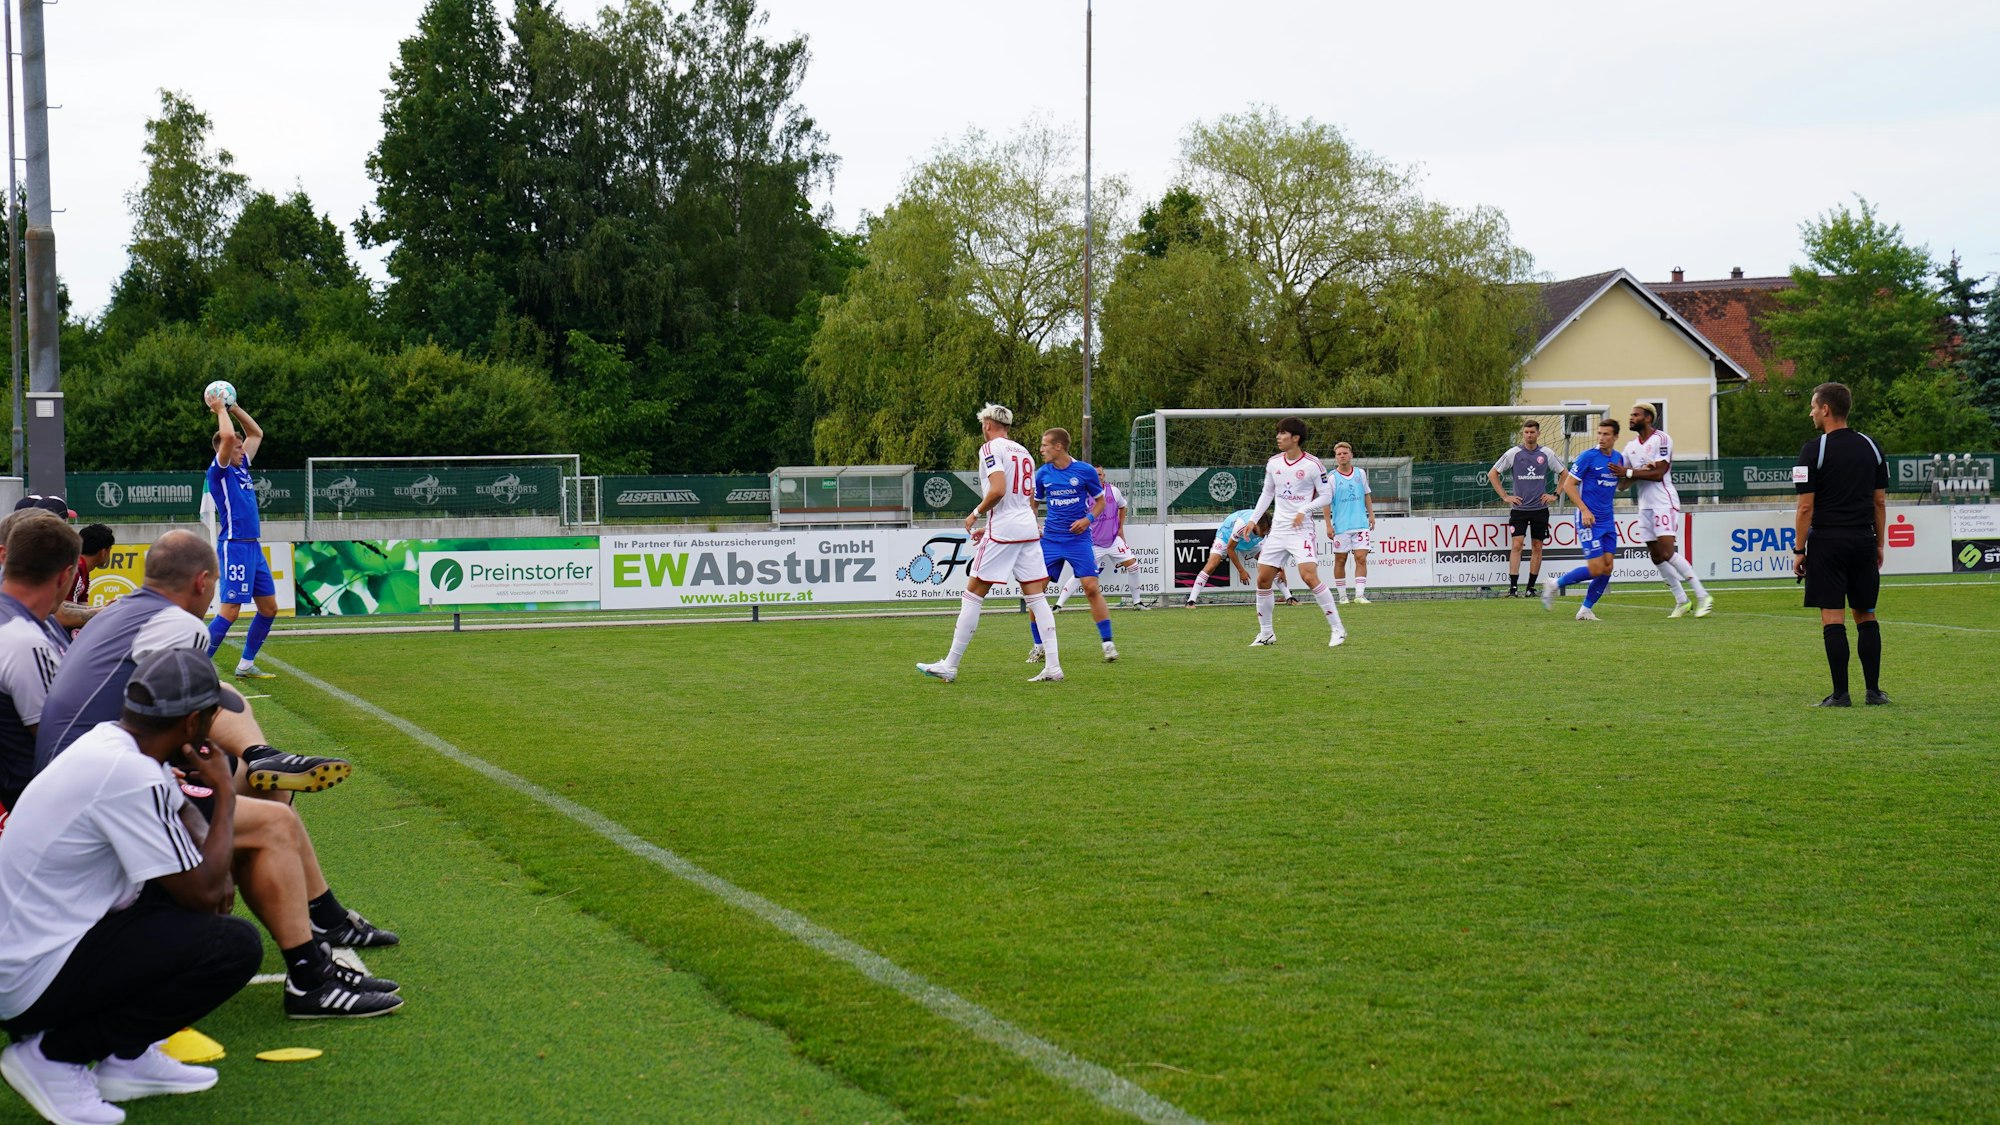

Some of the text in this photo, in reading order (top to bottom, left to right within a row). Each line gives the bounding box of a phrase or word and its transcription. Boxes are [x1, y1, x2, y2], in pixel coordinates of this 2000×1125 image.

[1011, 455, 1033, 496] 18
[1672, 472, 1721, 483] SENAUER
[1744, 466, 1793, 482] ROSENA
[127, 485, 192, 497] KAUFMANN
[259, 489, 290, 498] SPORTS
[344, 487, 375, 496] SPORTS
[394, 486, 457, 496] GLOBAL SPORTS
[476, 485, 538, 495] GLOBAL SPORTS
[616, 492, 700, 503] GASPERLMAYR
[1655, 514, 1669, 527] 20
[614, 537, 796, 549] Ihr Partner für Absturzsicherungen!
[1303, 540, 1312, 551] 4
[1379, 536, 1427, 553] TÜREN
[1731, 527, 1796, 552] SPAR
[818, 539, 875, 554] GmbH
[1731, 557, 1763, 573] Bad
[229, 564, 246, 581] 33
[470, 562, 593, 582] Preinstorfer
[1438, 573, 1455, 583] Tel:
[1459, 573, 1486, 583] 07614
[103, 585, 120, 593] VON
[895, 588, 918, 600] 4532
[680, 589, 814, 604] www.absturz.at
